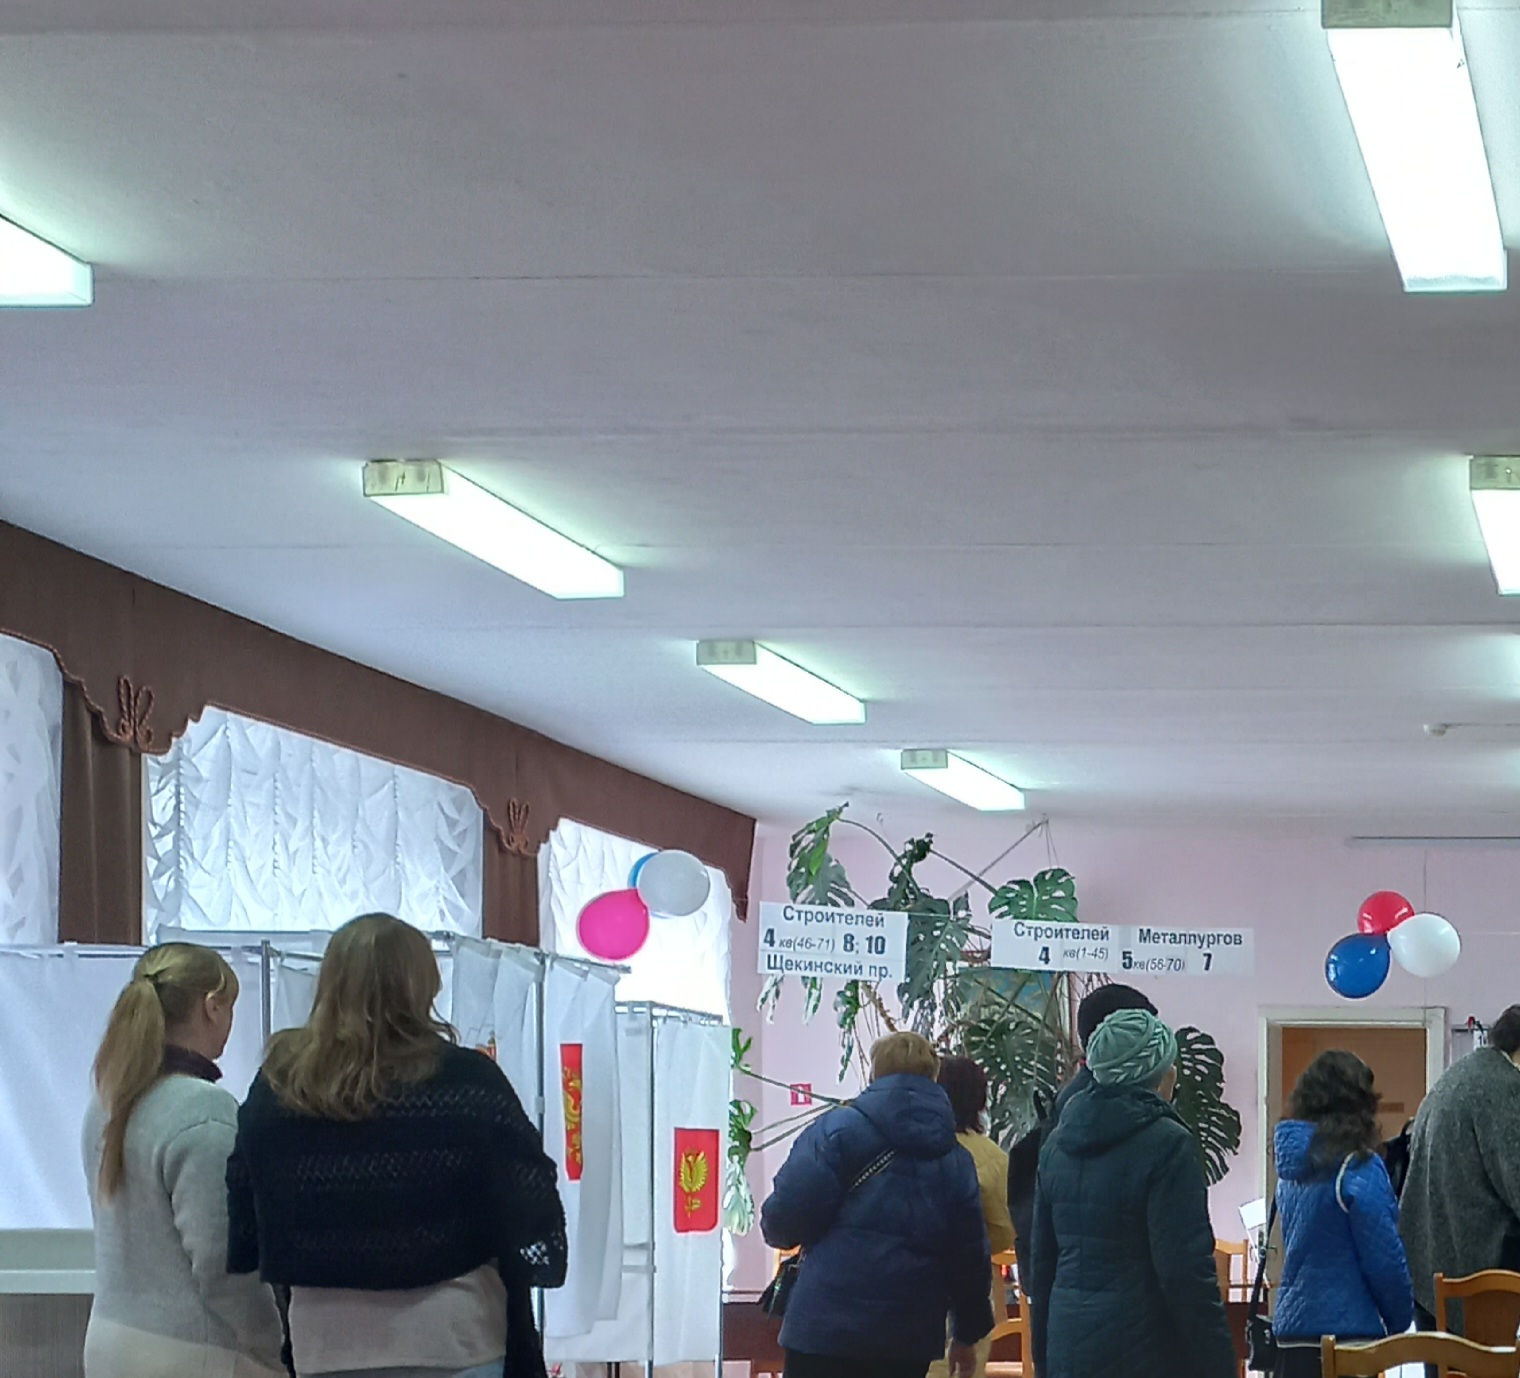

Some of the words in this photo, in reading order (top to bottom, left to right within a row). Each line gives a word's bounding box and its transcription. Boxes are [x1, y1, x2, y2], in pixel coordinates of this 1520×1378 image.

[782, 905, 885, 928] Строителей
[763, 928, 776, 947] 4
[865, 935, 886, 955] 10
[1013, 922, 1110, 941] Строителей
[1138, 928, 1243, 949] Металлургов
[1038, 946, 1051, 965] 4
[1202, 952, 1213, 971] 7
[767, 953, 864, 976] Щекинский
[868, 965, 893, 982] пр.
